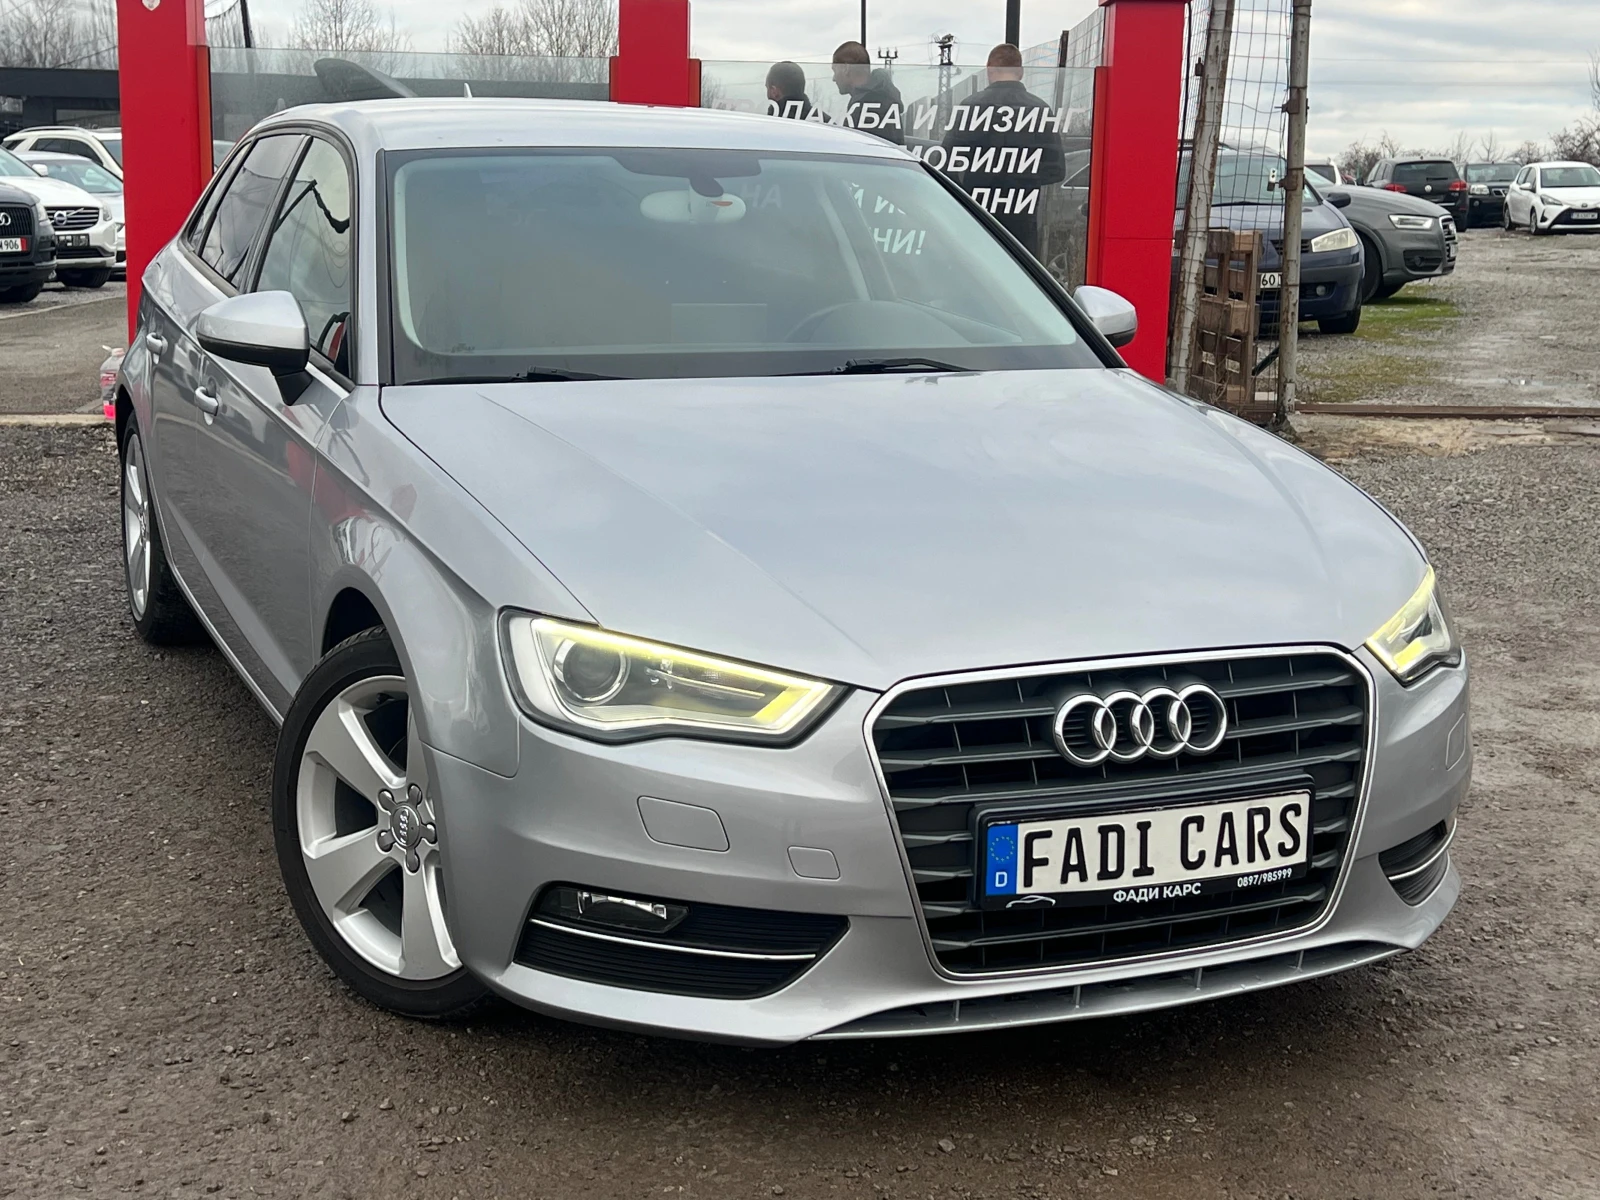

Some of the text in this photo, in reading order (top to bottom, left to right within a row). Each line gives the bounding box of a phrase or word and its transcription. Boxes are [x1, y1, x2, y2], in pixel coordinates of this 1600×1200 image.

[913, 104, 938, 130] И
[944, 105, 1086, 133] ЛИЗИНГ
[869, 226, 926, 255] НИ!
[1023, 803, 1302, 888] FADI CARS
[995, 871, 1008, 888] D
[1237, 868, 1293, 888] 0897/985999
[1113, 883, 1202, 903] ФАДИ КАРС
